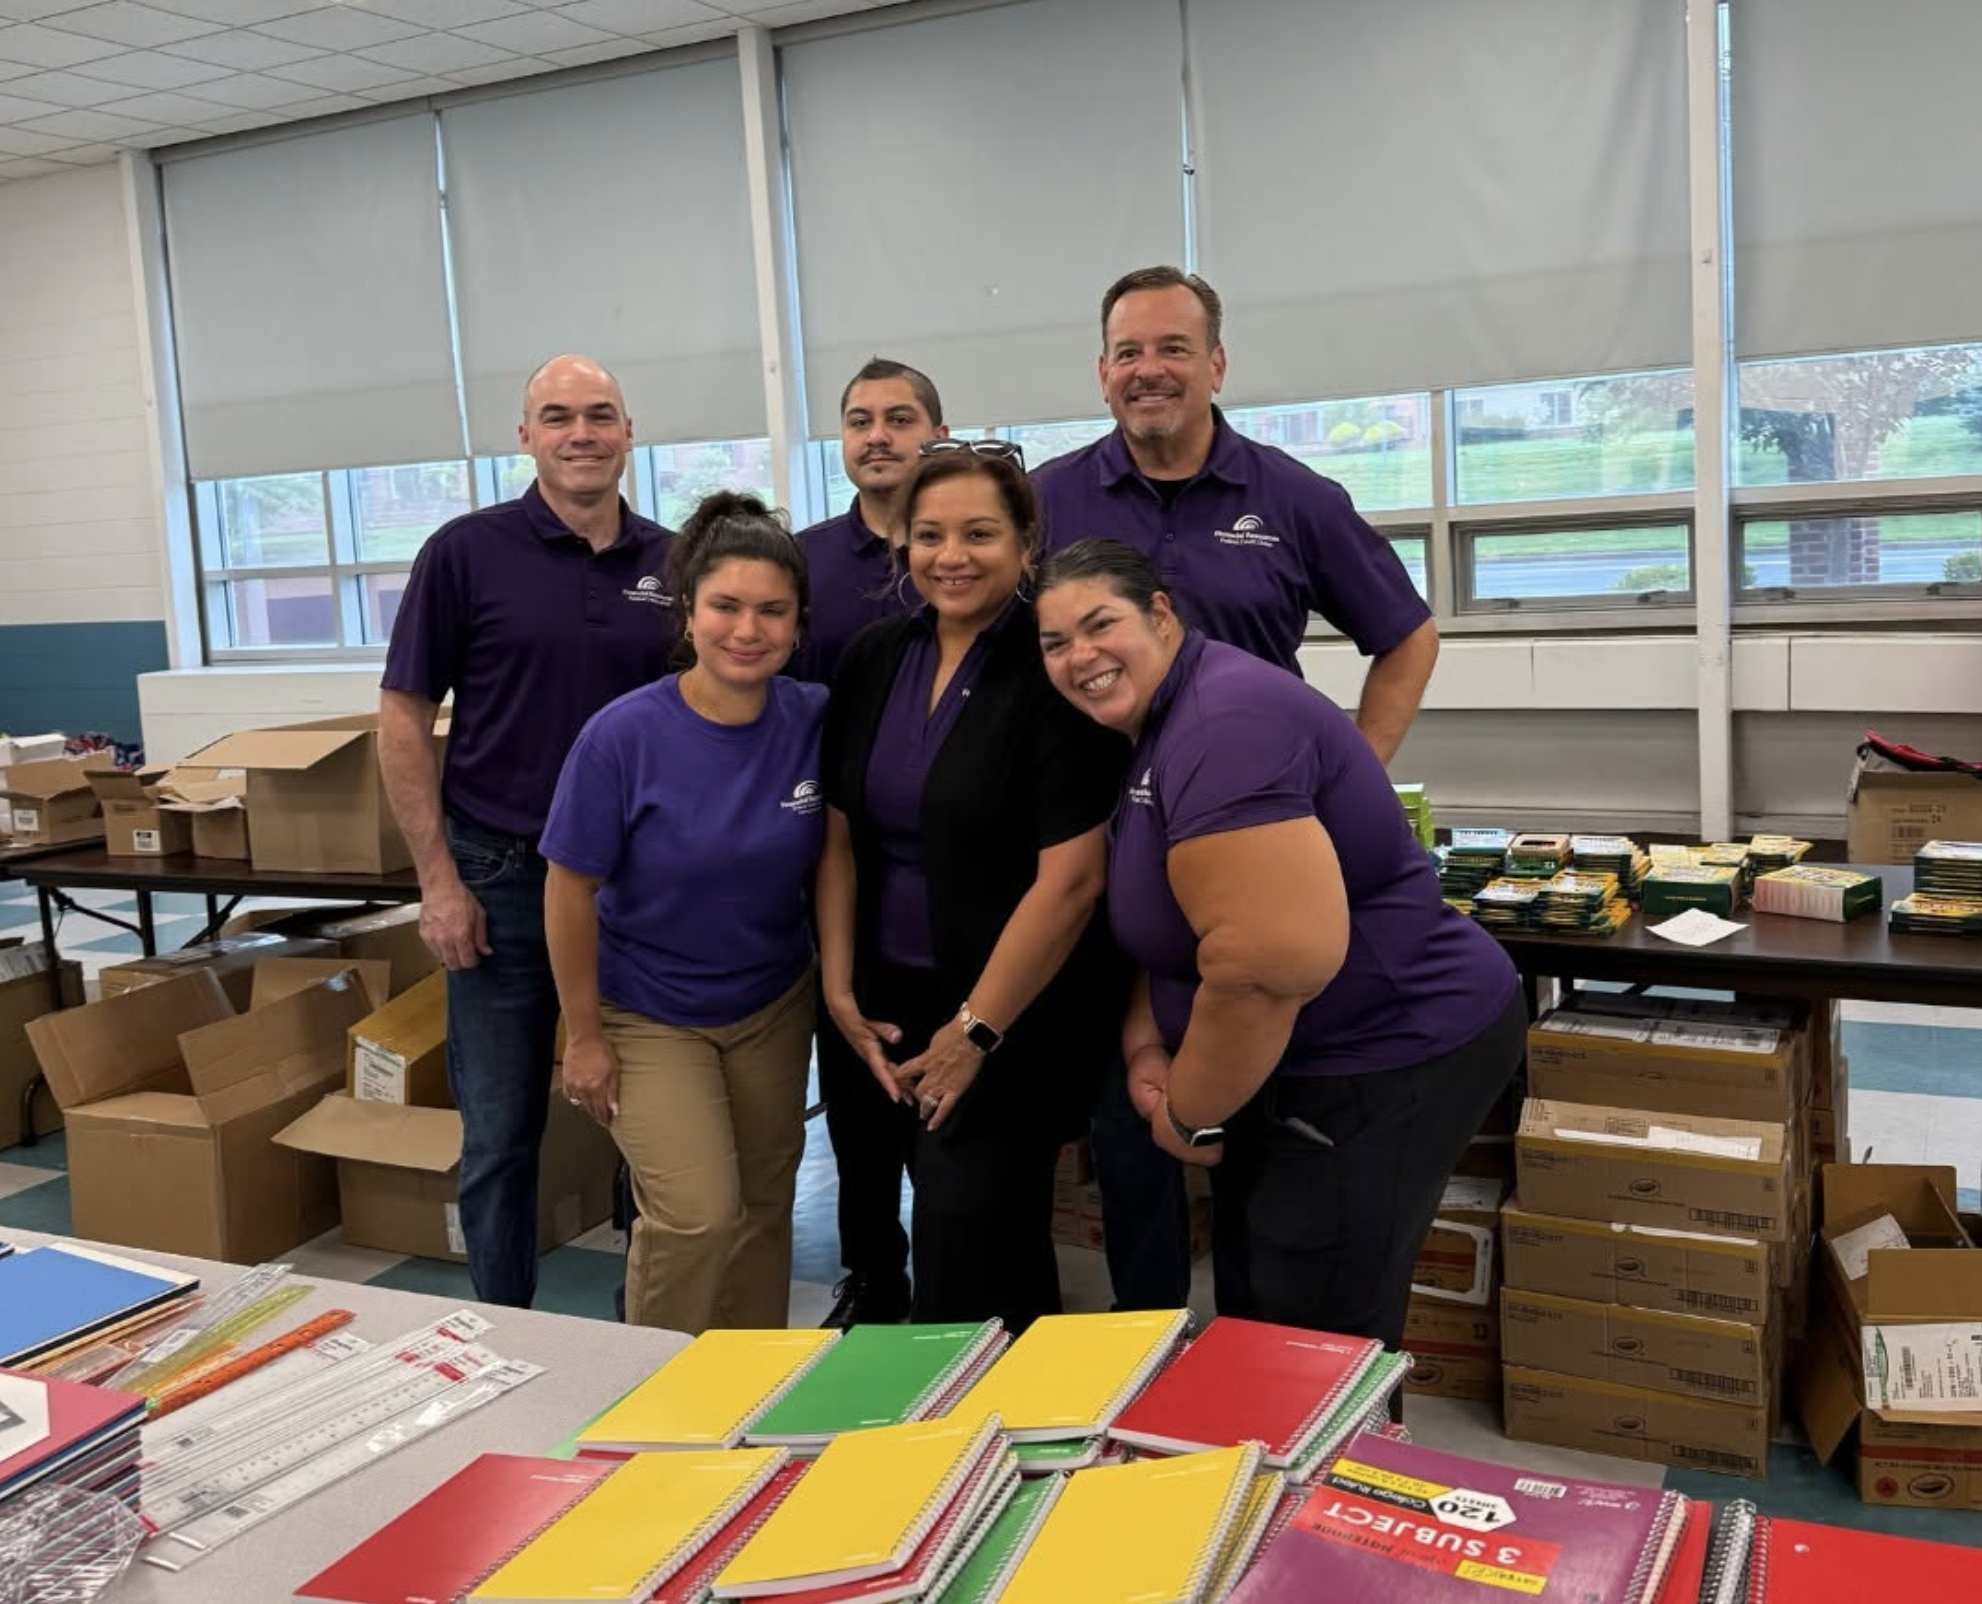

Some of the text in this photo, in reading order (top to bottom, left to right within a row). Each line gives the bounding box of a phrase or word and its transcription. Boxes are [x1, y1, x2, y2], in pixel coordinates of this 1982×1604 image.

[1437, 1501, 1501, 1522] 120
[1323, 1502, 1487, 1557] SUBJECT
[1496, 1547, 1522, 1564] 3
